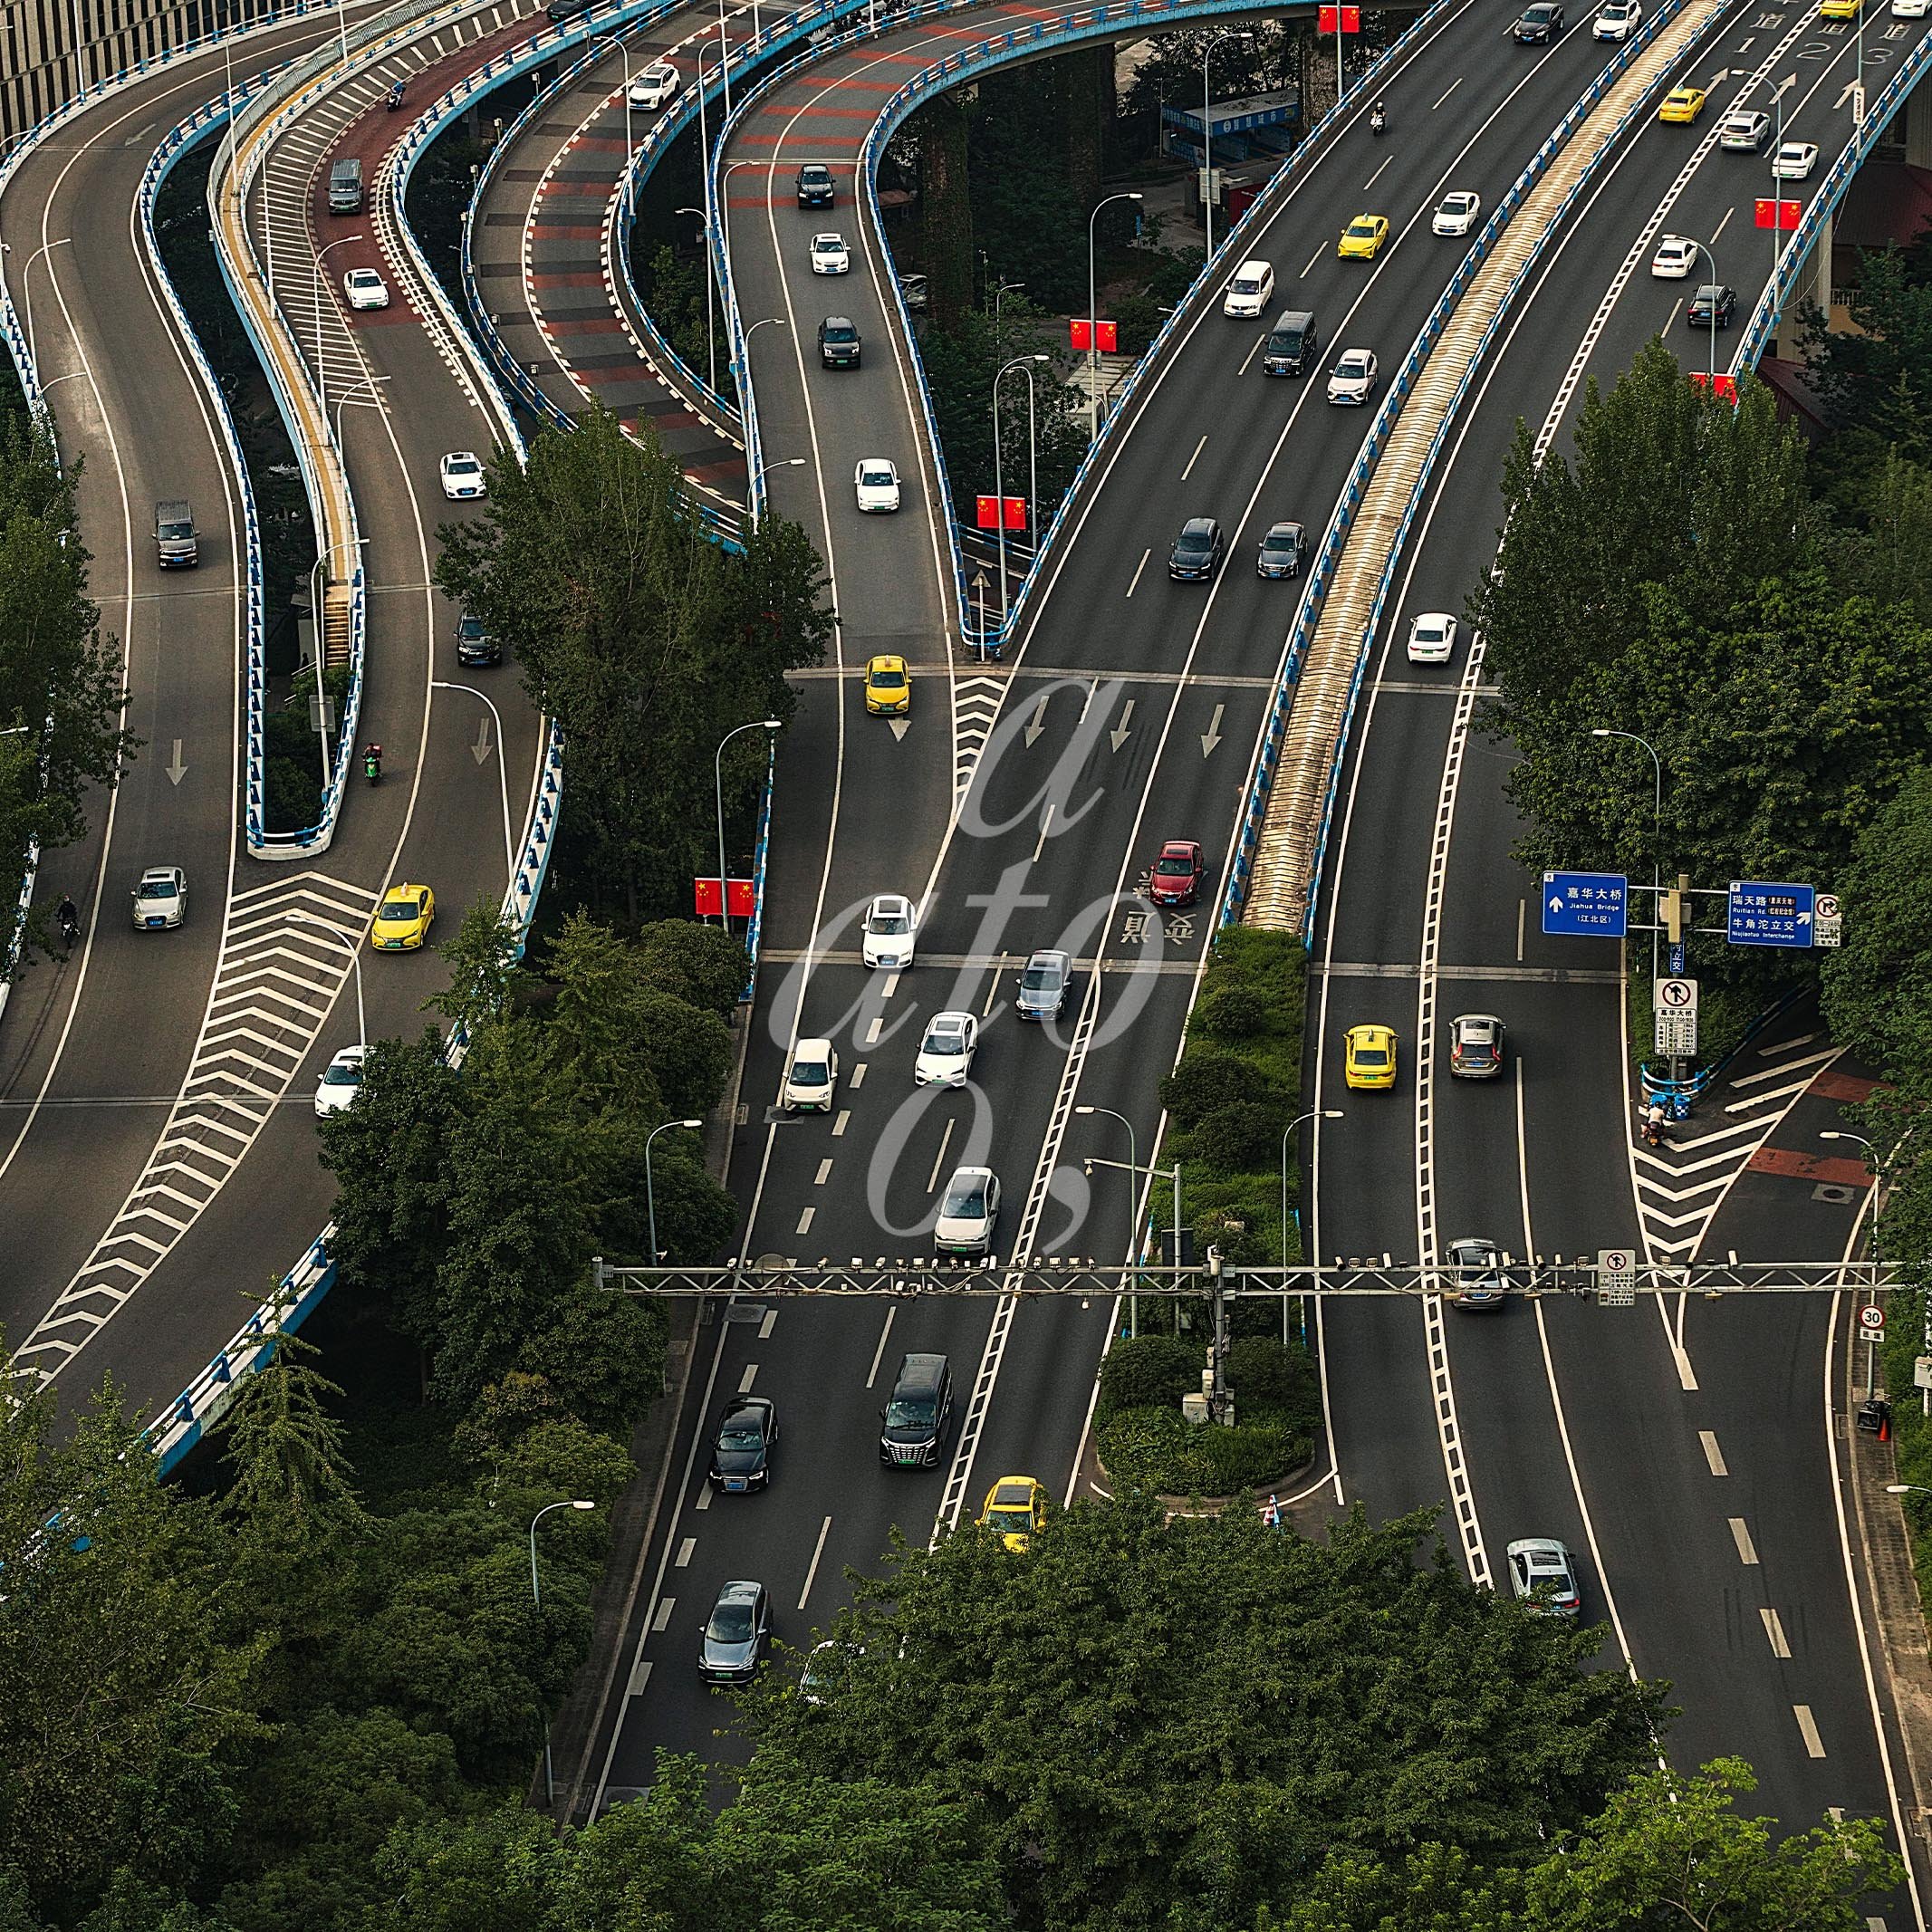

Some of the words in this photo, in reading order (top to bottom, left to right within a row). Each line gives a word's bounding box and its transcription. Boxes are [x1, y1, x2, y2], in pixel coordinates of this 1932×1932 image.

[1734, 37, 1755, 53] 1
[1796, 43, 1831, 60] 2
[1861, 48, 1894, 64] 3
[1567, 887, 1622, 900] 嘉华大桥
[1732, 895, 1767, 907] 瑞天路
[1597, 904, 1620, 912] Bridge
[1577, 914, 1611, 924] (江北区)
[1732, 918, 1794, 931] 牛角沱立交
[1864, 1312, 1880, 1323] 30
